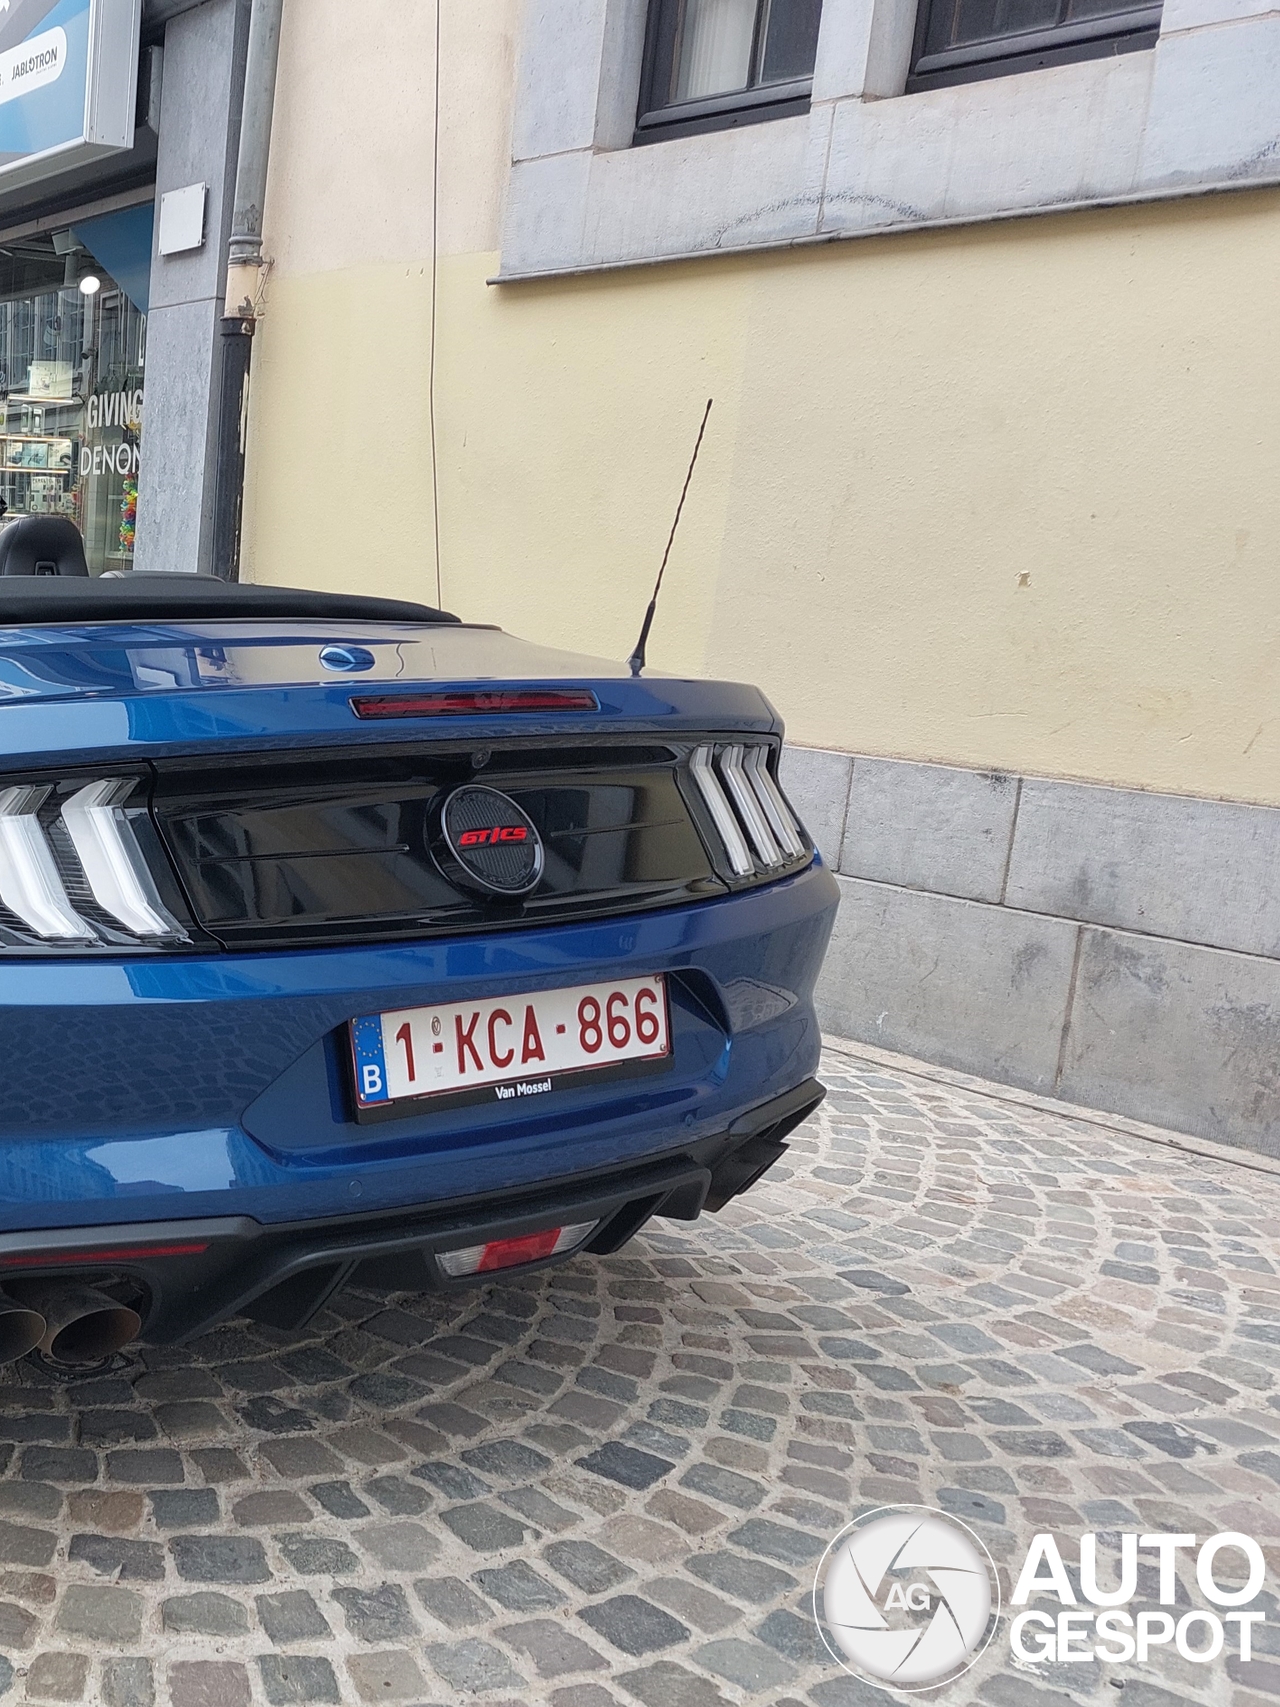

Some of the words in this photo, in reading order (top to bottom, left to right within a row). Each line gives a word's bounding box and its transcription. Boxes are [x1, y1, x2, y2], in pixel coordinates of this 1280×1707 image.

[11, 46, 58, 81] JABLOTRON
[87, 389, 143, 429] GIVING
[363, 1064, 383, 1094] B
[495, 1085, 516, 1100] Van
[517, 1078, 552, 1098] Mossel
